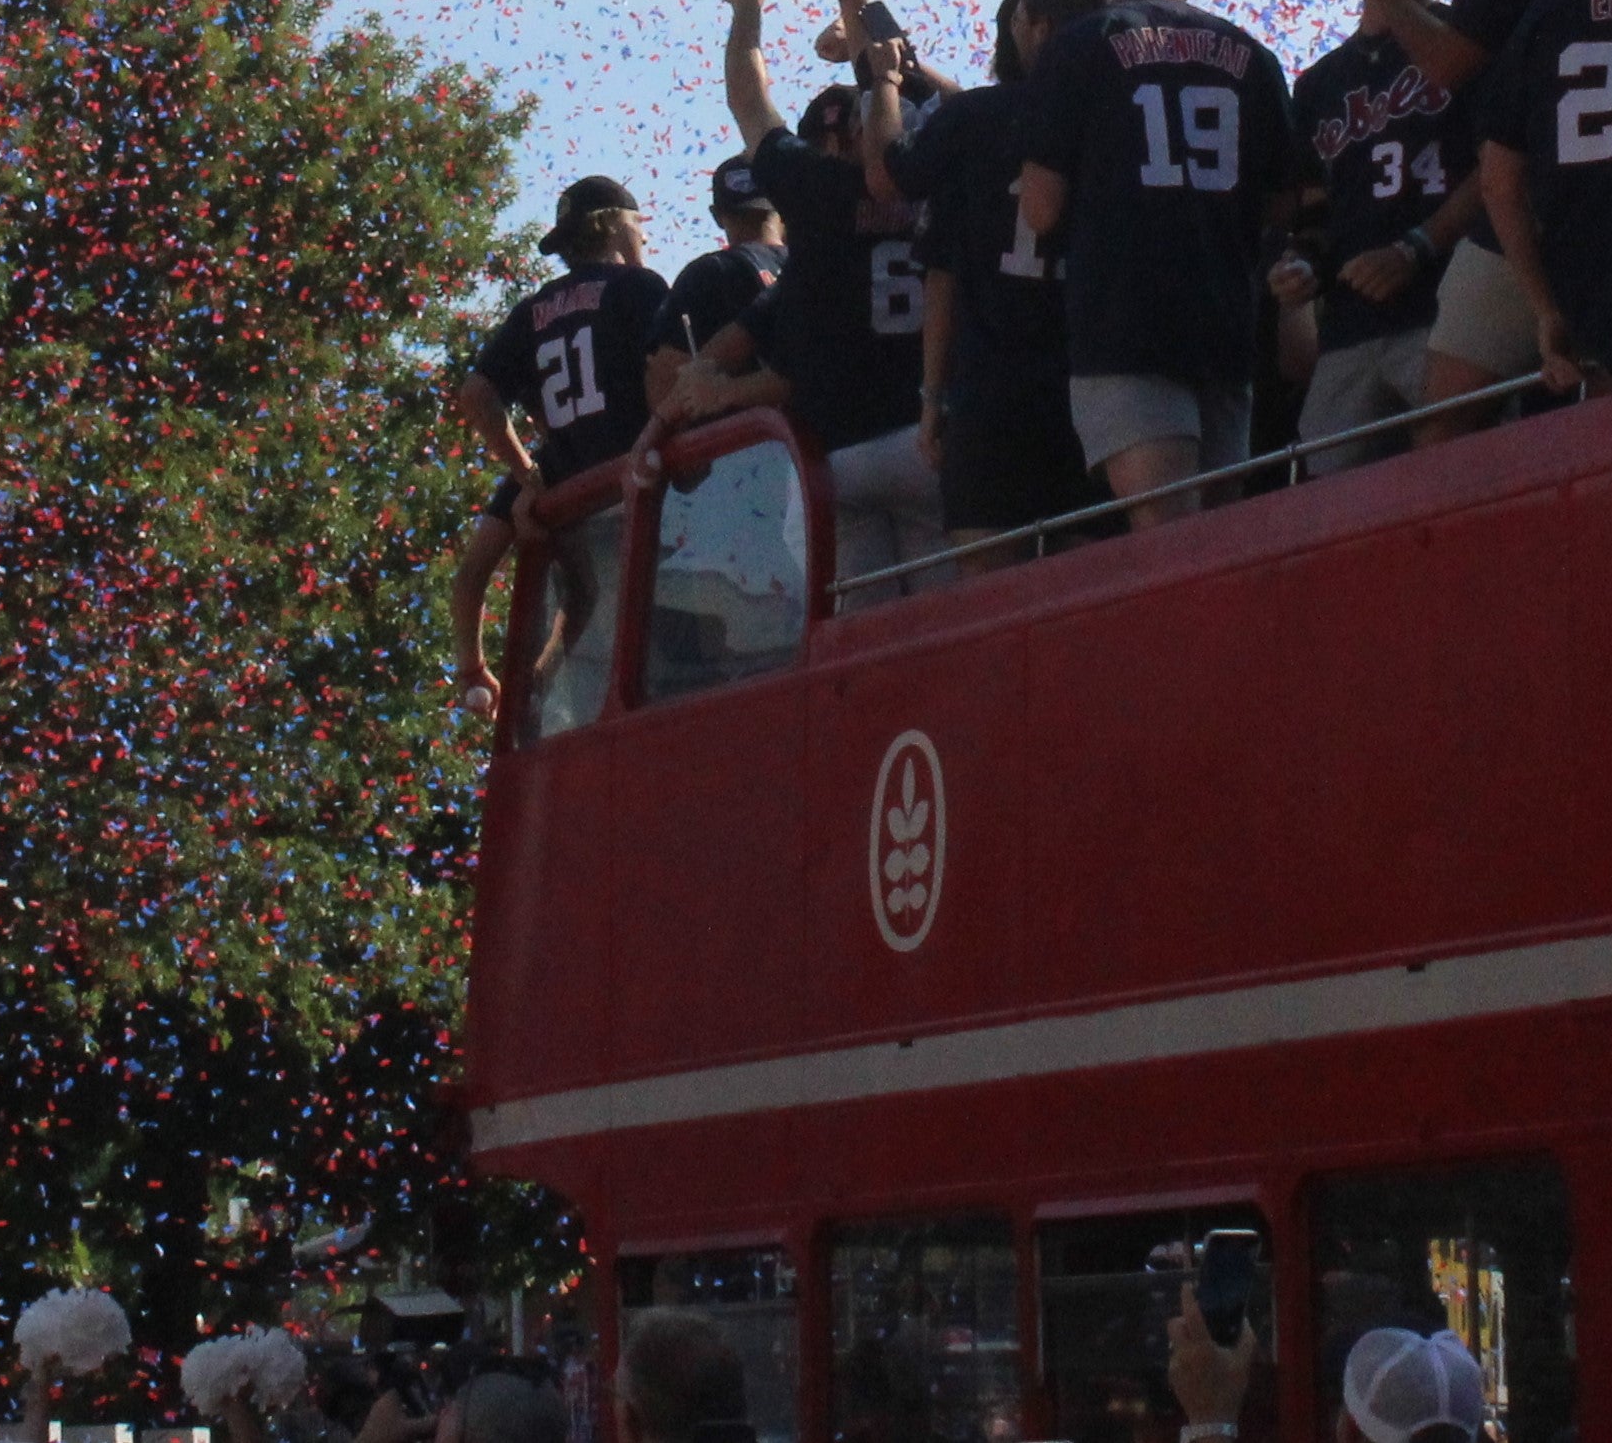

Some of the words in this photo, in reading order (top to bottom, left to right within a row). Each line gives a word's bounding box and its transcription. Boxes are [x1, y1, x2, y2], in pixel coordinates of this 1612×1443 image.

[1132, 82, 1241, 192] 19
[1370, 139, 1448, 200] 34
[535, 324, 606, 430] 21
